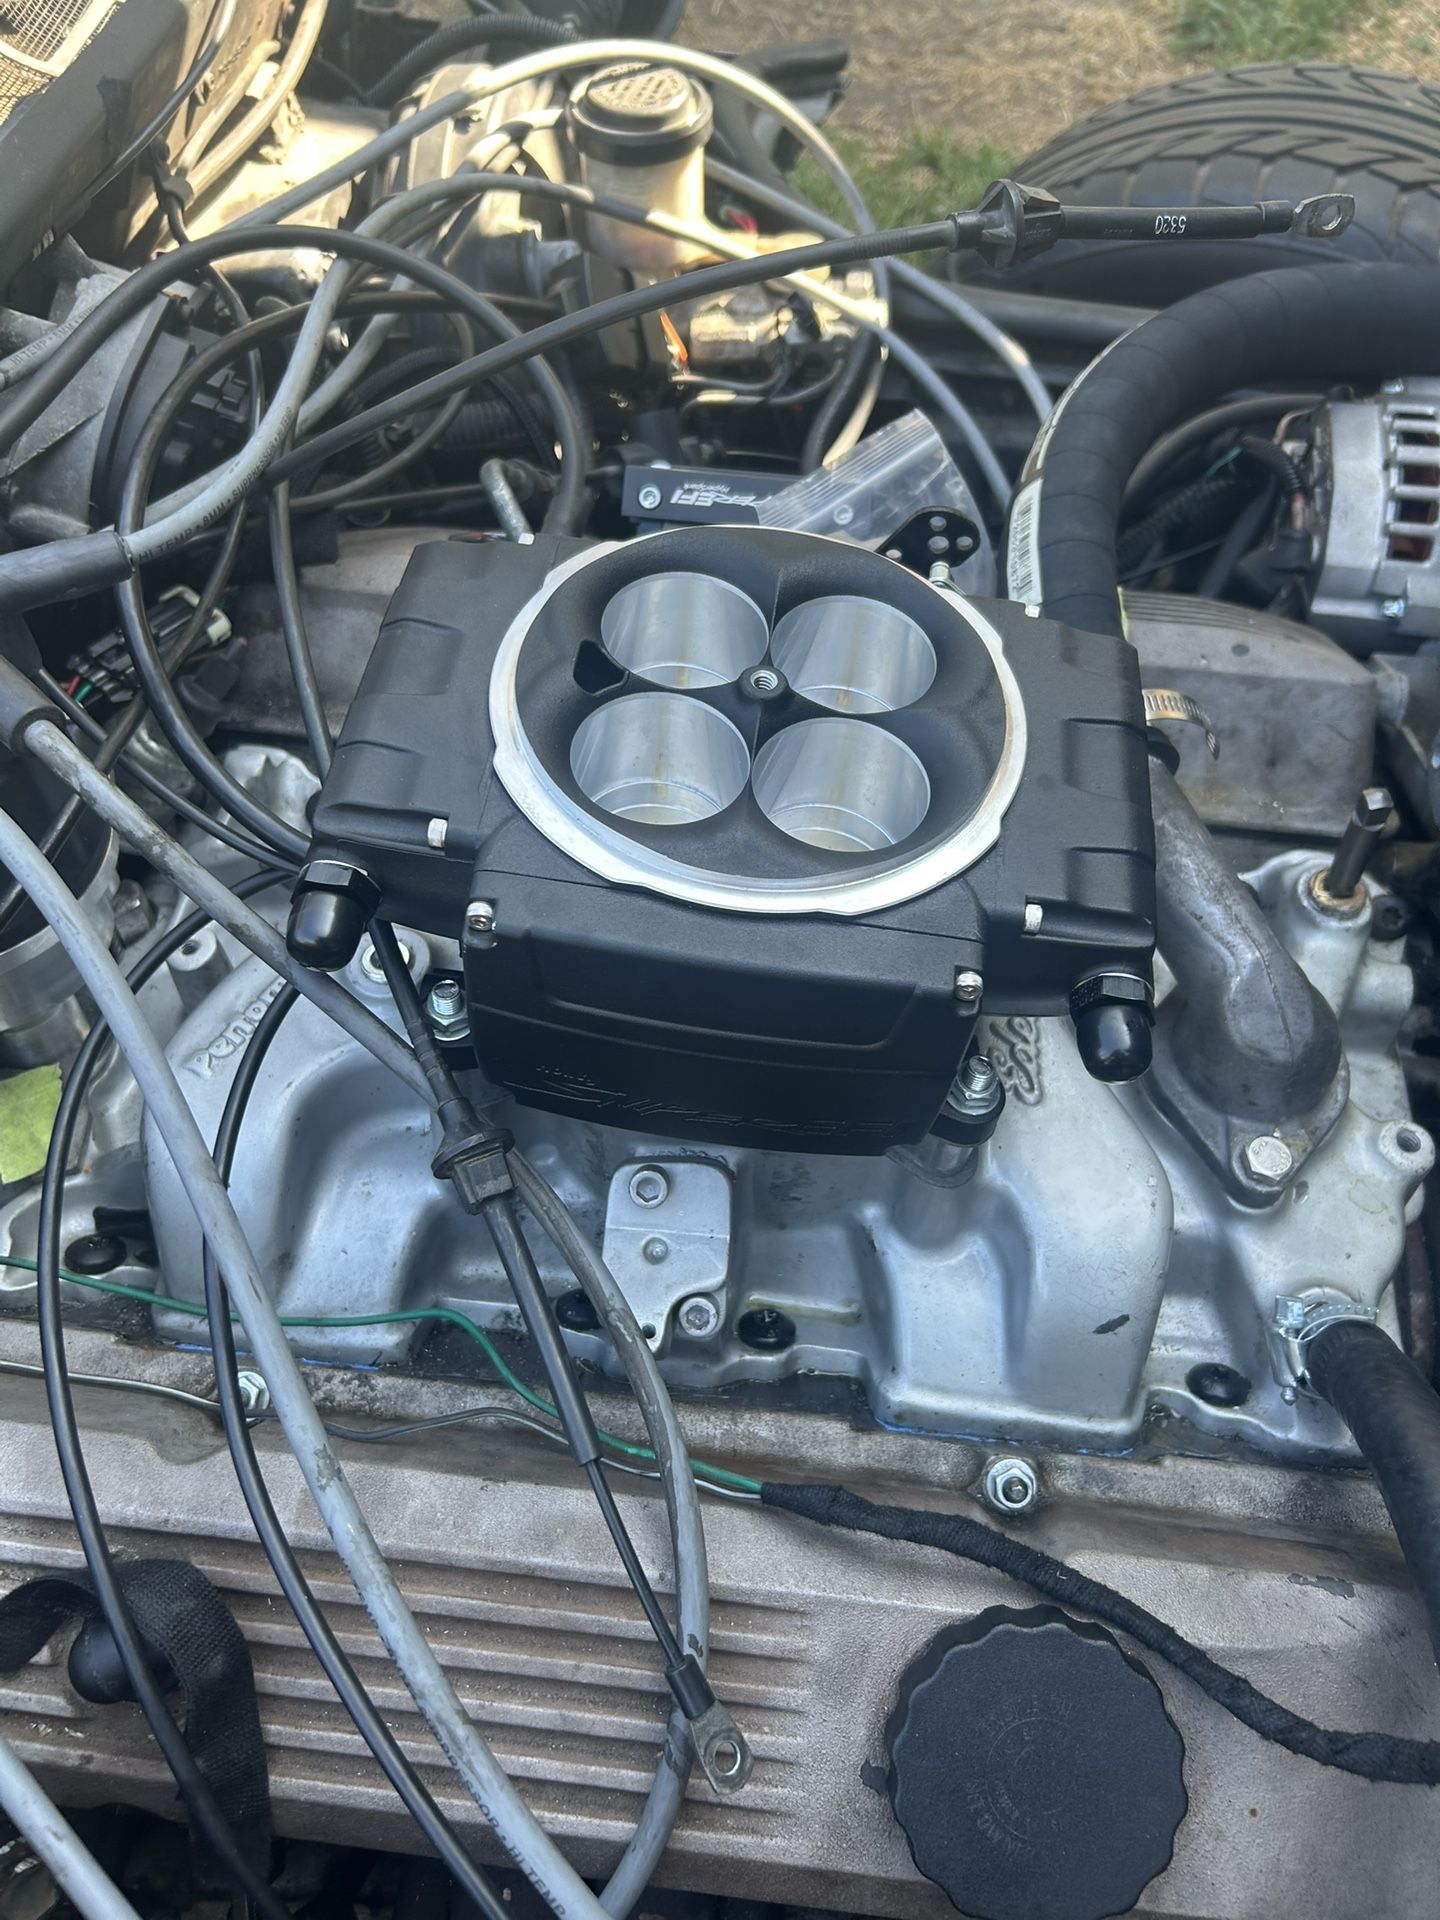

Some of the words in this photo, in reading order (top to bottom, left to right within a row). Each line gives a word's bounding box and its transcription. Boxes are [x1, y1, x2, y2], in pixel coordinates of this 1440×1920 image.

[1155, 215, 1187, 235] 5320
[158, 527, 194, 552] TEMP
[202, 502, 227, 527] 8MM
[508, 1845, 526, 1866] HI
[528, 1867, 567, 1917] TEMP
